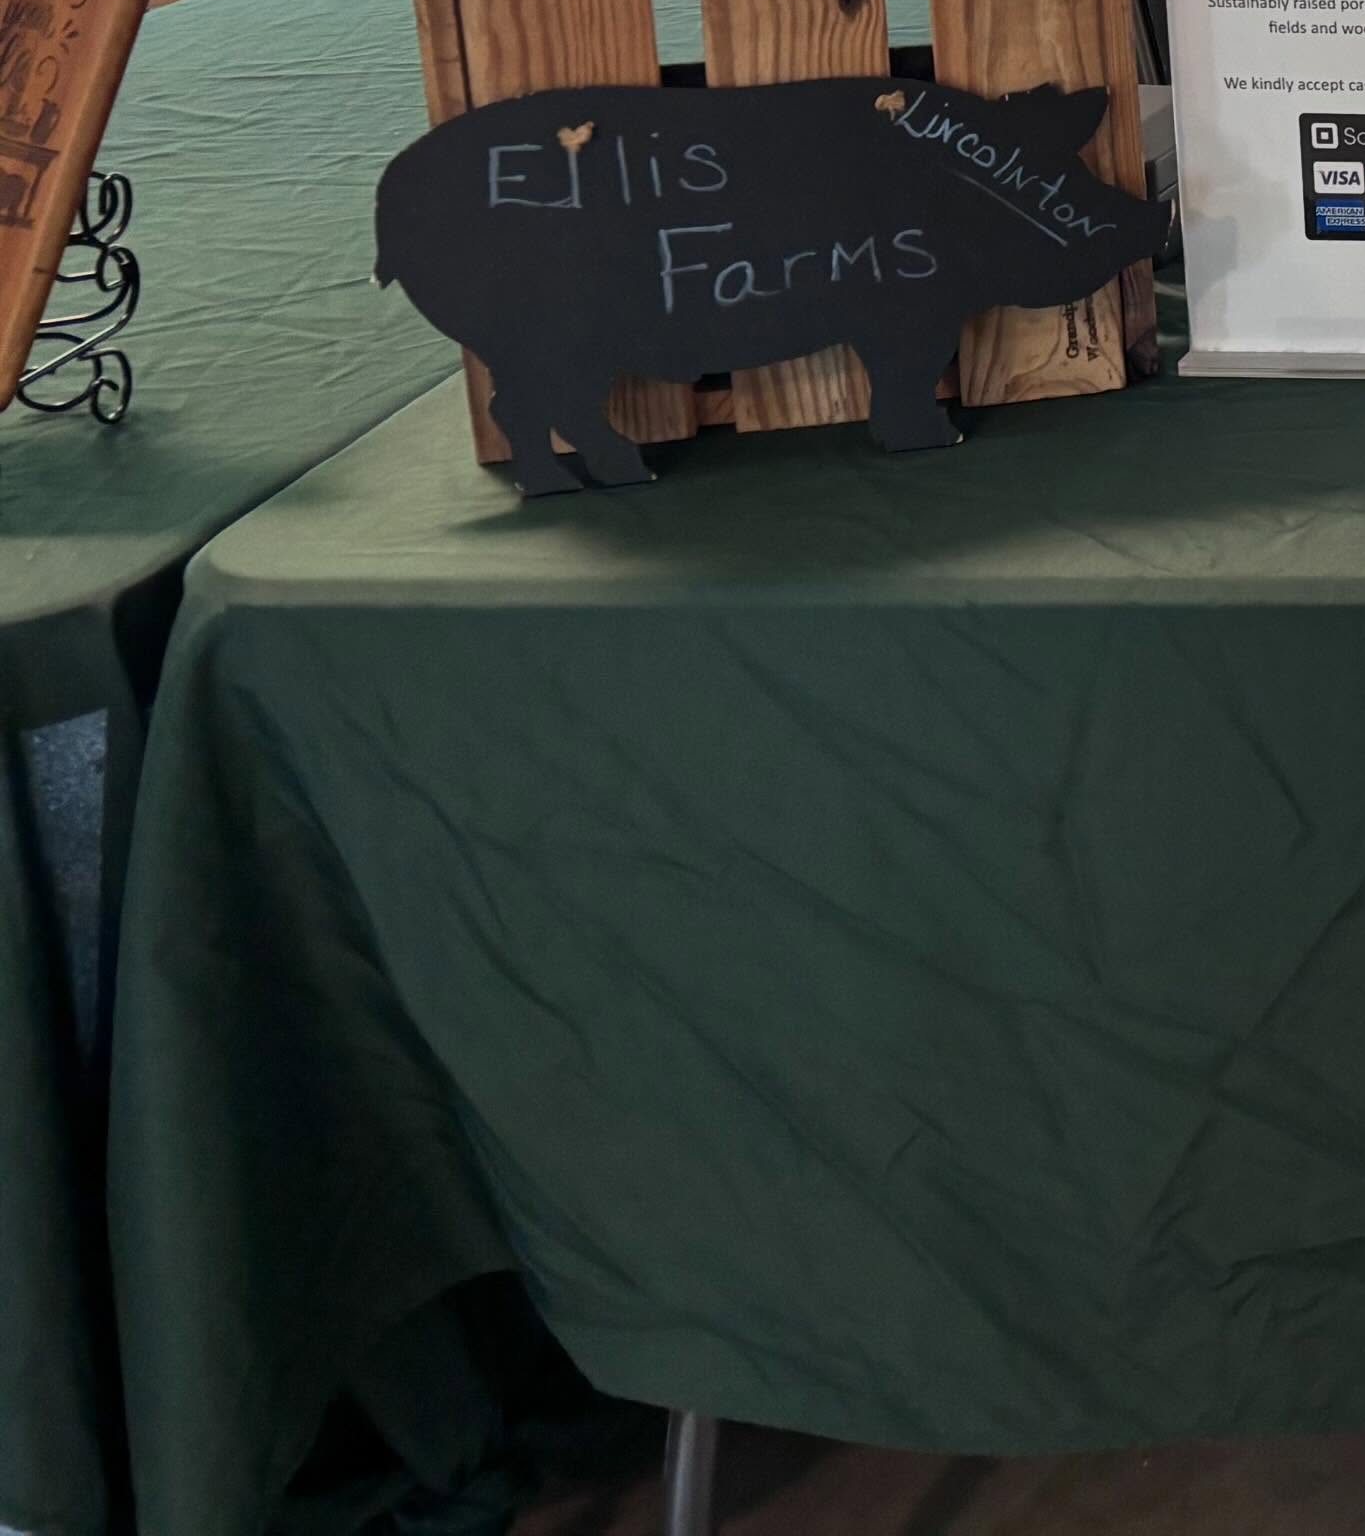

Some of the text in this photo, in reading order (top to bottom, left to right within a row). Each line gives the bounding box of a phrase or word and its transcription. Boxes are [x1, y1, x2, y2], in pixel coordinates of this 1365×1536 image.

[1268, 20, 1307, 35] fields
[1311, 21, 1338, 35] and
[1224, 76, 1247, 90] We
[1251, 77, 1294, 93] kindly
[1298, 79, 1345, 94] accept
[488, 131, 729, 209] Ellis
[1319, 170, 1361, 186] VISA
